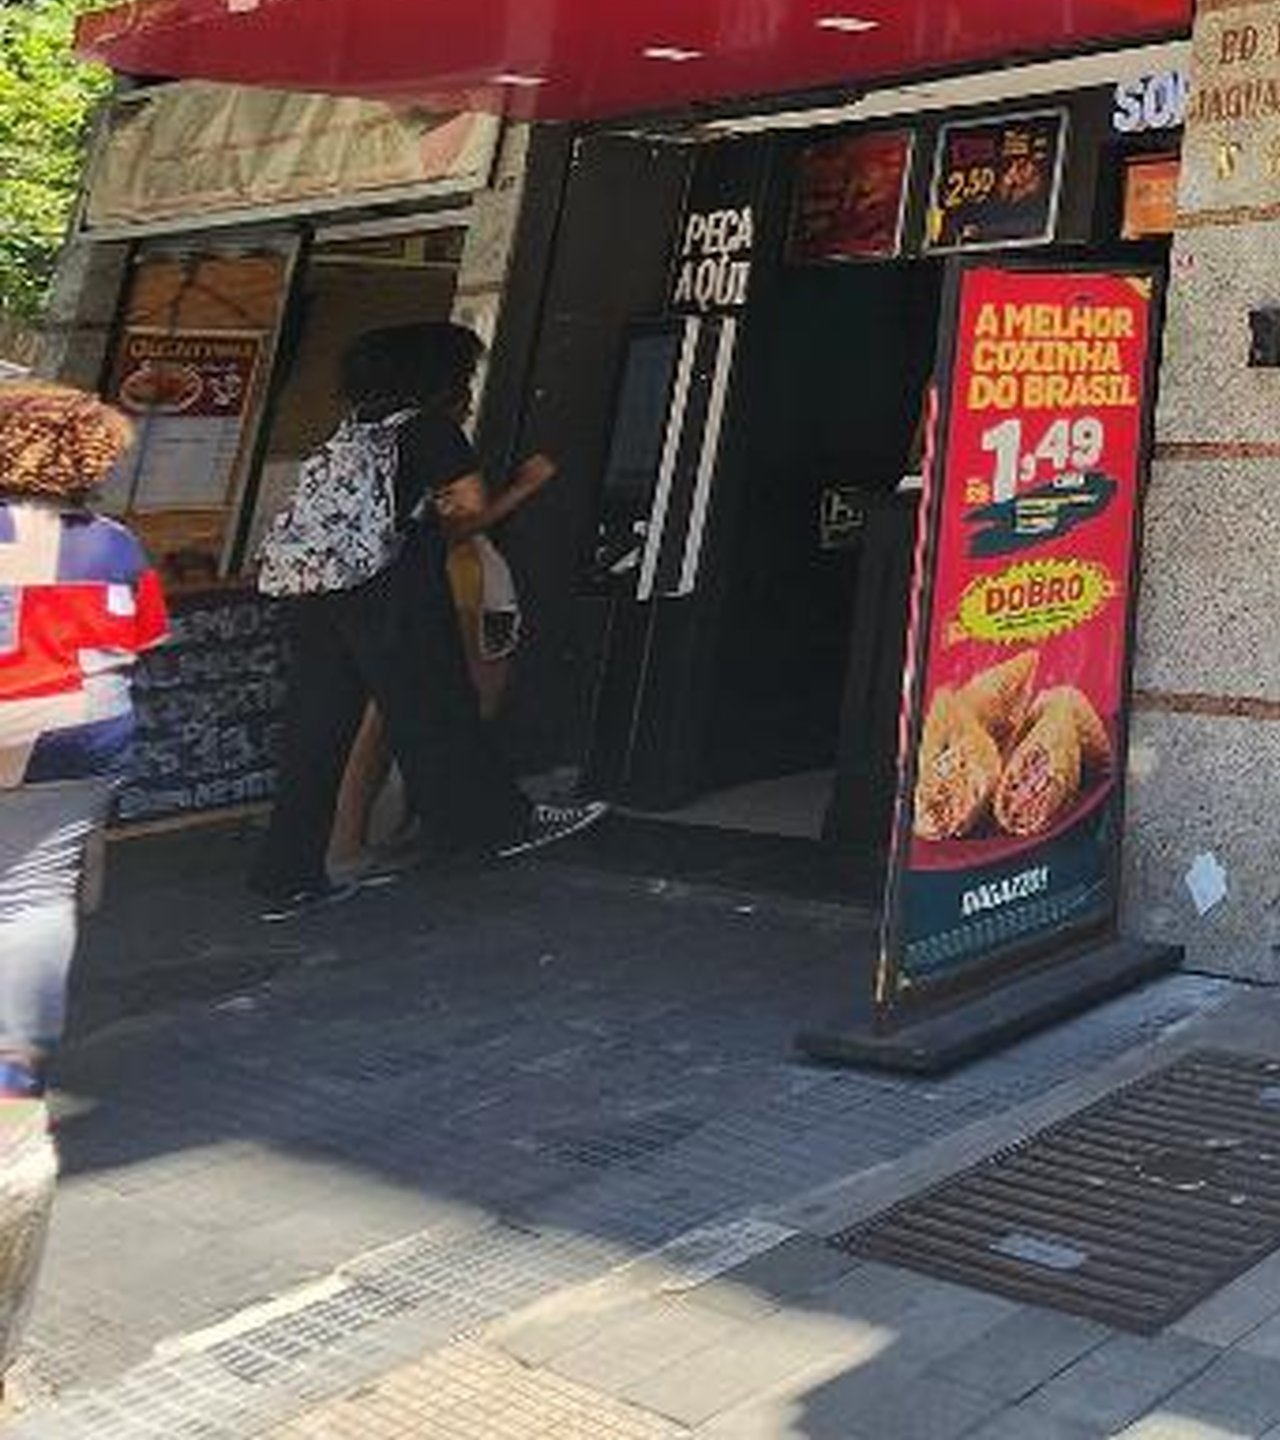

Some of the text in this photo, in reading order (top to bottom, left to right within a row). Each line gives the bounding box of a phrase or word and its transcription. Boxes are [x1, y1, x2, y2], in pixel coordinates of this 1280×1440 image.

[674, 259, 751, 311] AQUI
[974, 302, 1134, 338] A MELHOR
[973, 340, 1122, 373] COXINHA
[967, 374, 1137, 409] DO BRASIL
[982, 417, 1104, 503] 1,49
[986, 574, 1085, 615] DOBRO
